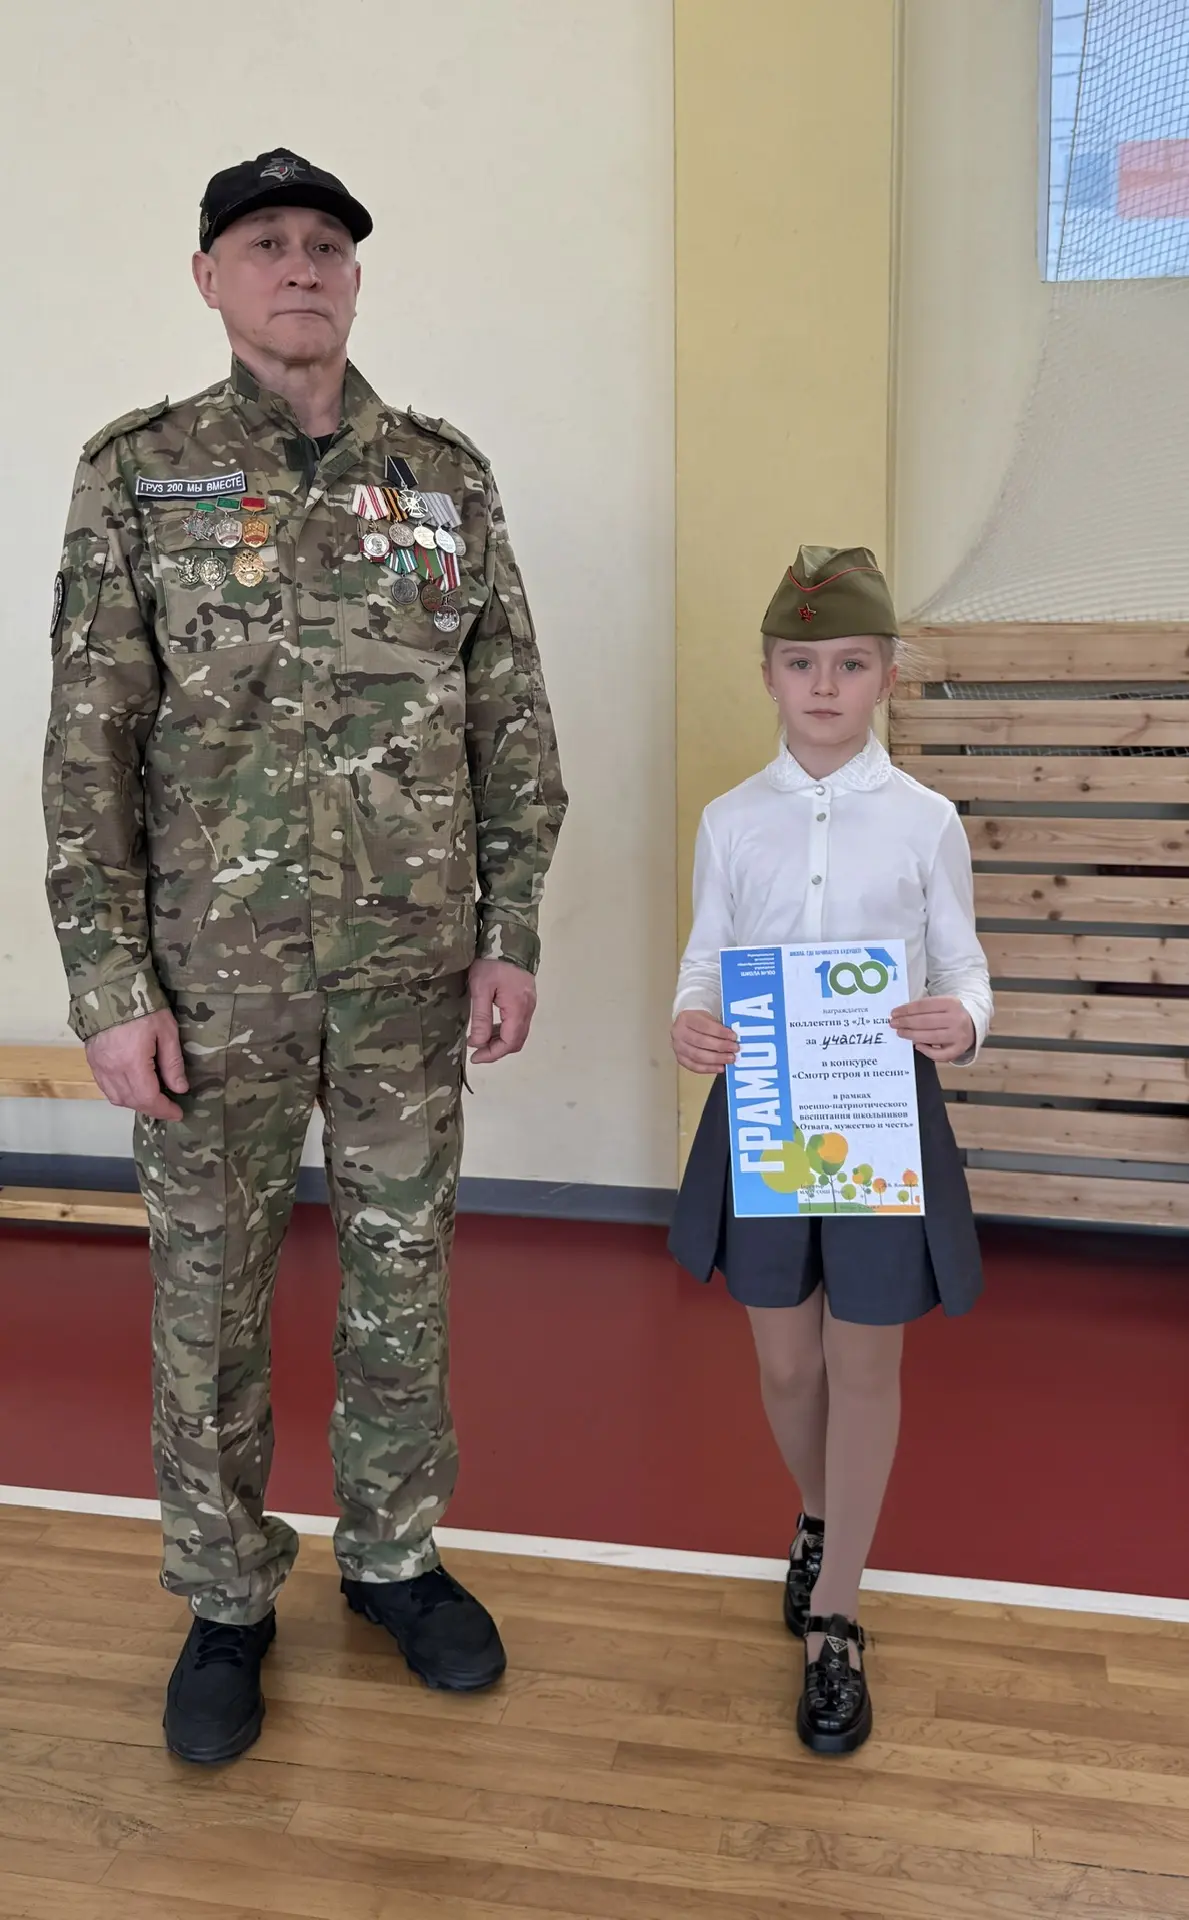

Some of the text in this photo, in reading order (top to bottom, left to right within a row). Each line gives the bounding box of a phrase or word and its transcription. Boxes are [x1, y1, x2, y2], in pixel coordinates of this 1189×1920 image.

[141, 477, 242, 493] ГРУЗ 200 МЫ ВМЕСТЕ
[814, 960, 889, 998] 100
[823, 1007, 869, 1015] награждается
[789, 1020, 842, 1028] коллектив
[843, 1019, 850, 1027] 3
[873, 1017, 890, 1025] кла
[830, 1058, 878, 1069] конкурсе
[792, 1071, 830, 1080] «Смотр
[831, 1071, 861, 1080] строя
[730, 993, 784, 1174] ГРАМОТА
[798, 1101, 908, 1110] военно-патриотического
[799, 1110, 908, 1121] воспитания школьников
[834, 1122, 876, 1130] мужество
[884, 1121, 914, 1129] честь»
